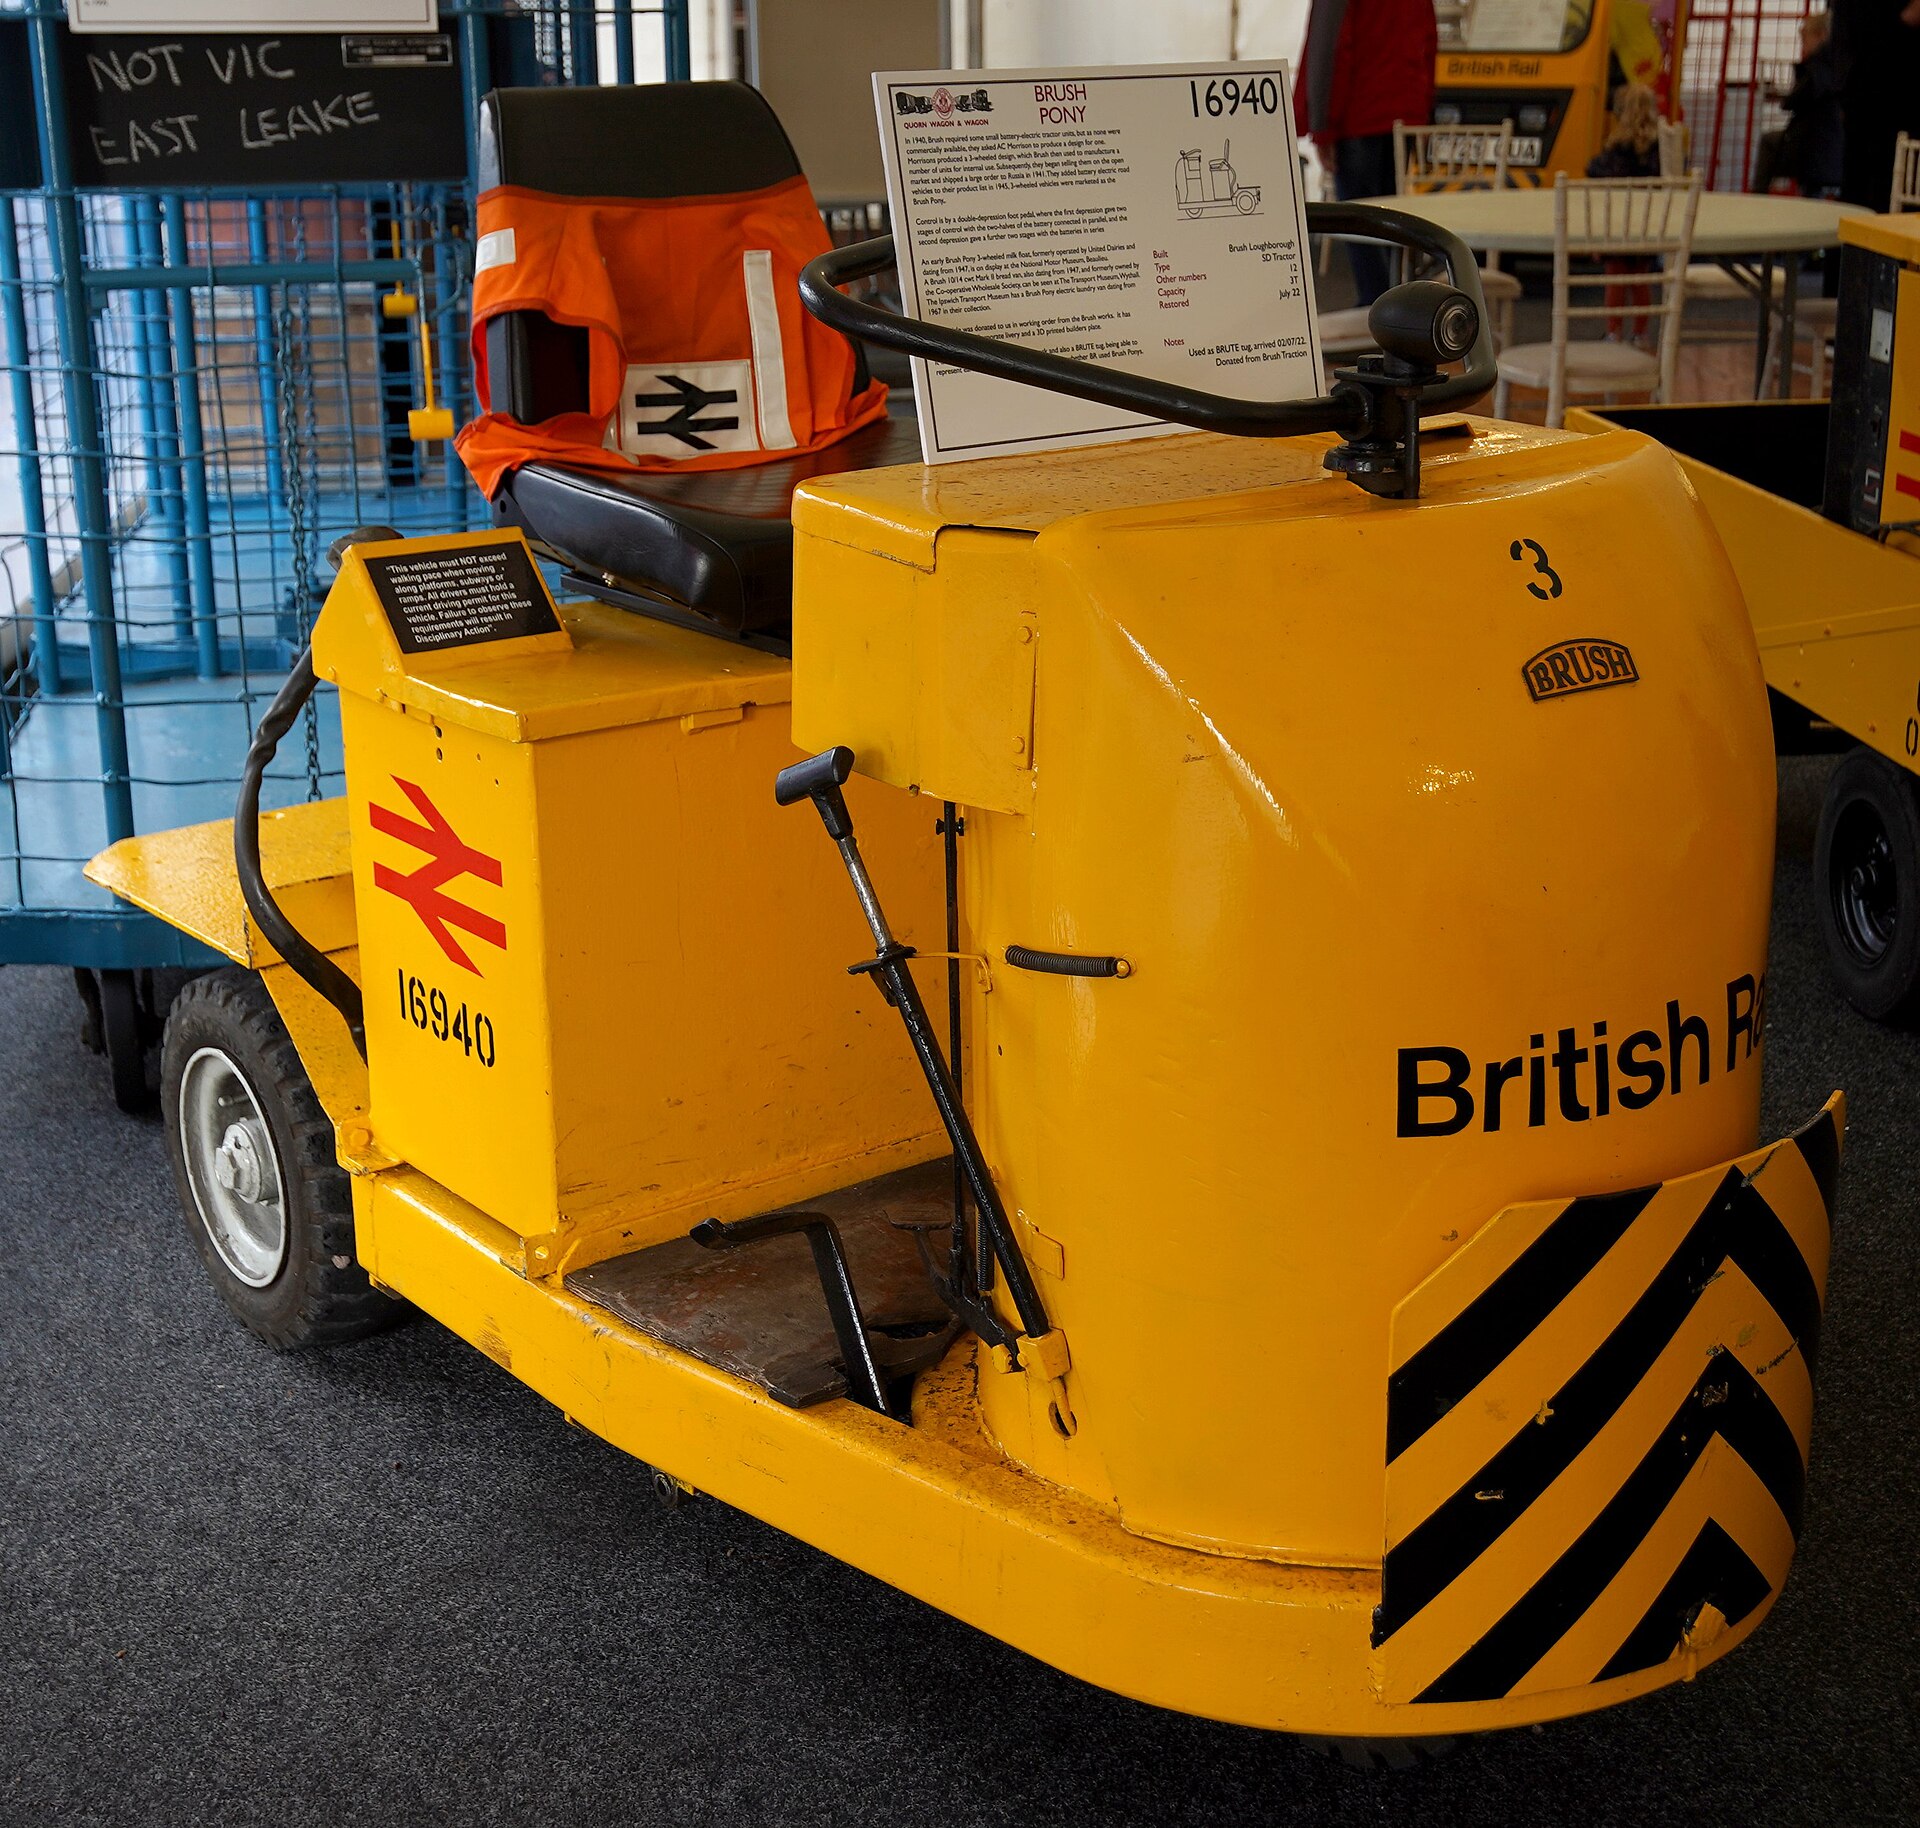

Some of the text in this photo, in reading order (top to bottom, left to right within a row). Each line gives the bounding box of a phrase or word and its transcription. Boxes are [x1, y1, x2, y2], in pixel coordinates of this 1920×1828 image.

[86, 43, 184, 92] NOT
[206, 40, 295, 85] VIC
[1034, 84, 1087, 102] BRUSH
[1190, 77, 1278, 117] 16940
[1039, 105, 1086, 124] PONY
[88, 91, 380, 164] EAST LEAKE
[903, 121, 927, 129] QUORN
[929, 120, 954, 128] WAGON
[911, 187, 933, 195] vehicles
[956, 185, 978, 194] product
[1010, 181, 1038, 189] 3-wheeled
[1074, 177, 1099, 185] marketed
[912, 197, 929, 205] Brush
[918, 237, 938, 245] second
[939, 236, 968, 245] depression
[1229, 240, 1295, 252] Brush Loughborough
[1152, 250, 1168, 259] Built
[1262, 252, 1296, 262] SD Tractor
[1154, 263, 1170, 273] Type
[1290, 264, 1298, 272] 12
[1156, 273, 1207, 284] Other numbers
[1290, 276, 1298, 284] 3T
[926, 298, 938, 306] The
[938, 296, 959, 306] Ipswich
[959, 295, 986, 303] Transport
[1025, 289, 1041, 297] Brush
[1041, 288, 1054, 296] Pony
[1158, 287, 1186, 298] Capacity
[1280, 288, 1300, 300] July 22
[928, 307, 941, 315] 1967
[949, 306, 962, 314] their
[1159, 300, 1190, 309] Restored
[974, 323, 996, 331] donated
[1004, 331, 1020, 339] livery
[1021, 329, 1031, 337] and
[1036, 326, 1045, 335] 3D
[1046, 326, 1065, 336] printed
[1048, 346, 1058, 354] and
[1075, 342, 1094, 351] BRUTE
[1164, 338, 1184, 347] Notes
[1188, 349, 1206, 357] Used
[1216, 344, 1240, 354] BRUTE
[1254, 340, 1276, 350] arrived
[1216, 350, 1308, 366] Donated from Brush Traction
[408, 561, 438, 571] vehicle
[438, 558, 459, 567] must
[459, 555, 476, 565] NOT
[478, 552, 506, 562] exceed
[1510, 538, 1563, 600] 3
[390, 565, 495, 583] walking pace when moving
[394, 585, 418, 593] along
[459, 575, 494, 585] subways
[427, 591, 439, 600] All
[439, 589, 467, 598] drivers
[468, 585, 489, 594] must
[488, 582, 508, 591] hold
[403, 591, 516, 613] current driving permit for this
[438, 609, 466, 619] Failure
[466, 607, 476, 615] to
[477, 603, 509, 613] observe
[509, 600, 532, 608] these
[411, 620, 464, 633] requirements
[464, 616, 479, 625] will
[480, 613, 503, 623] result
[414, 630, 462, 642] Disciplinary
[1530, 645, 1632, 693] BRUSH
[398, 968, 495, 1068] 16940
[1396, 999, 1710, 1138] British
